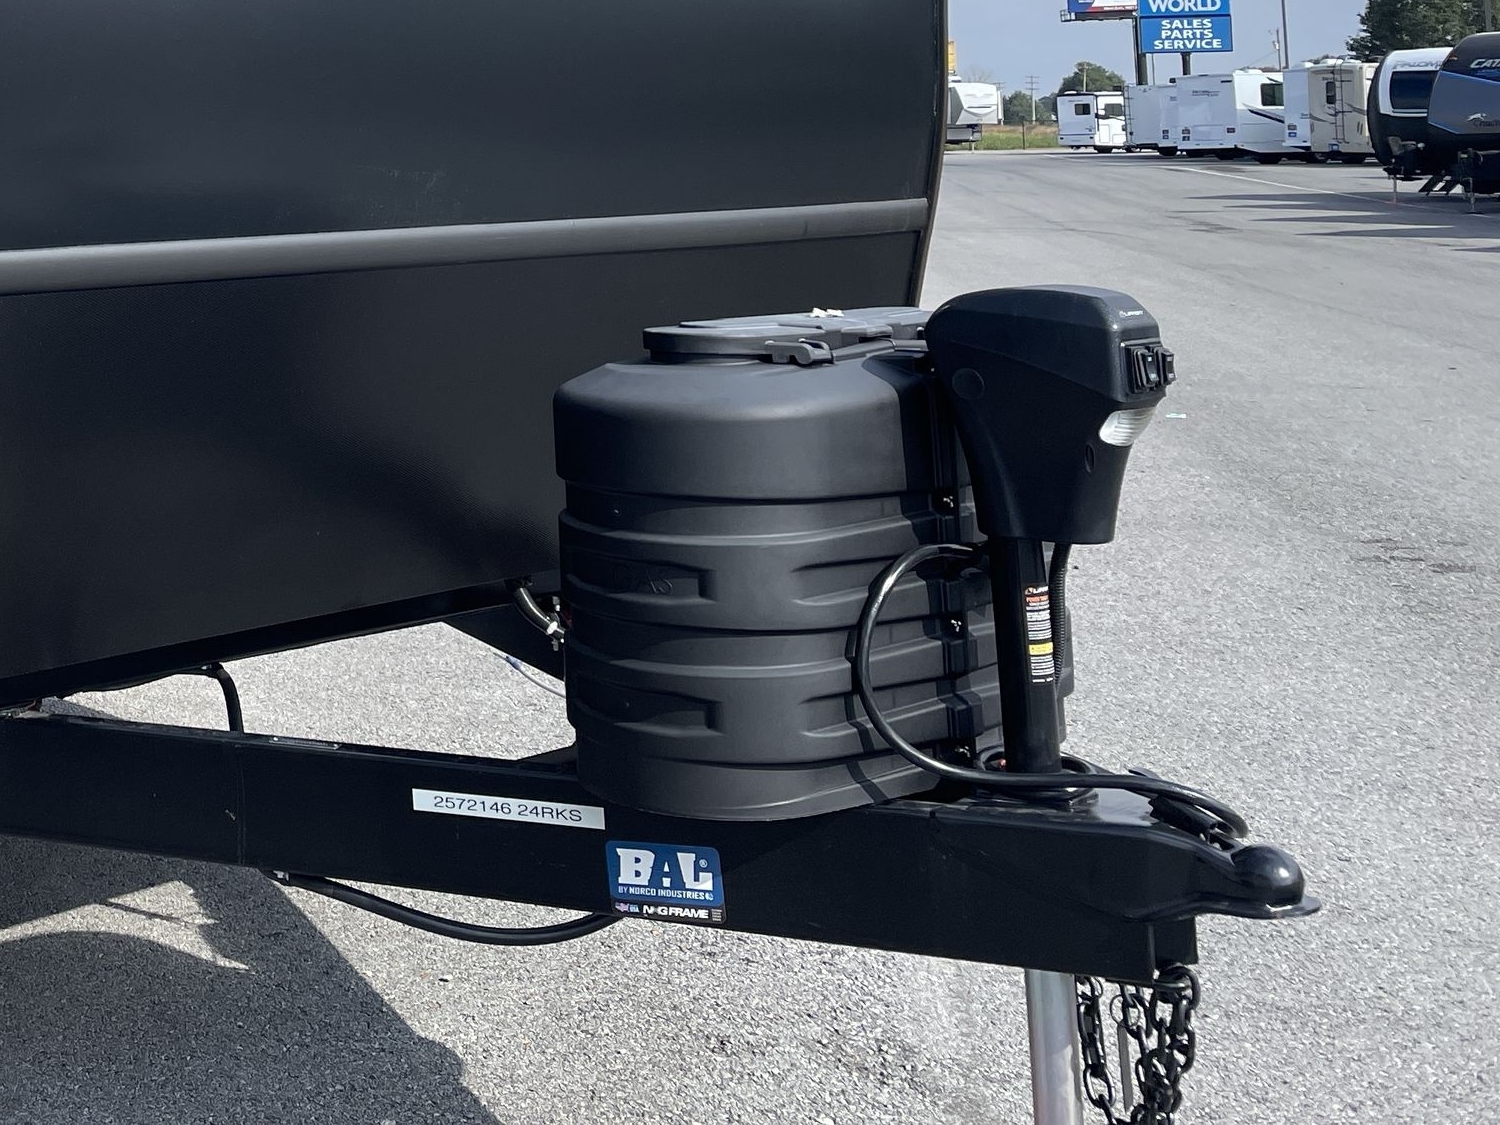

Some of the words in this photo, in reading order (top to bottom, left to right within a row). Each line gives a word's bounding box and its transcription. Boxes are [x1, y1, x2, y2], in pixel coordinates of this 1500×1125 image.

[1161, 19, 1212, 29] SALES
[1161, 29, 1213, 39] PARTS
[1154, 39, 1222, 49] SERVICE
[434, 795, 512, 815] 2572146
[517, 804, 583, 823] 24RKS
[618, 885, 628, 894] BY
[629, 886, 656, 896] NORCO
[658, 889, 705, 900] INDUSTRIES
